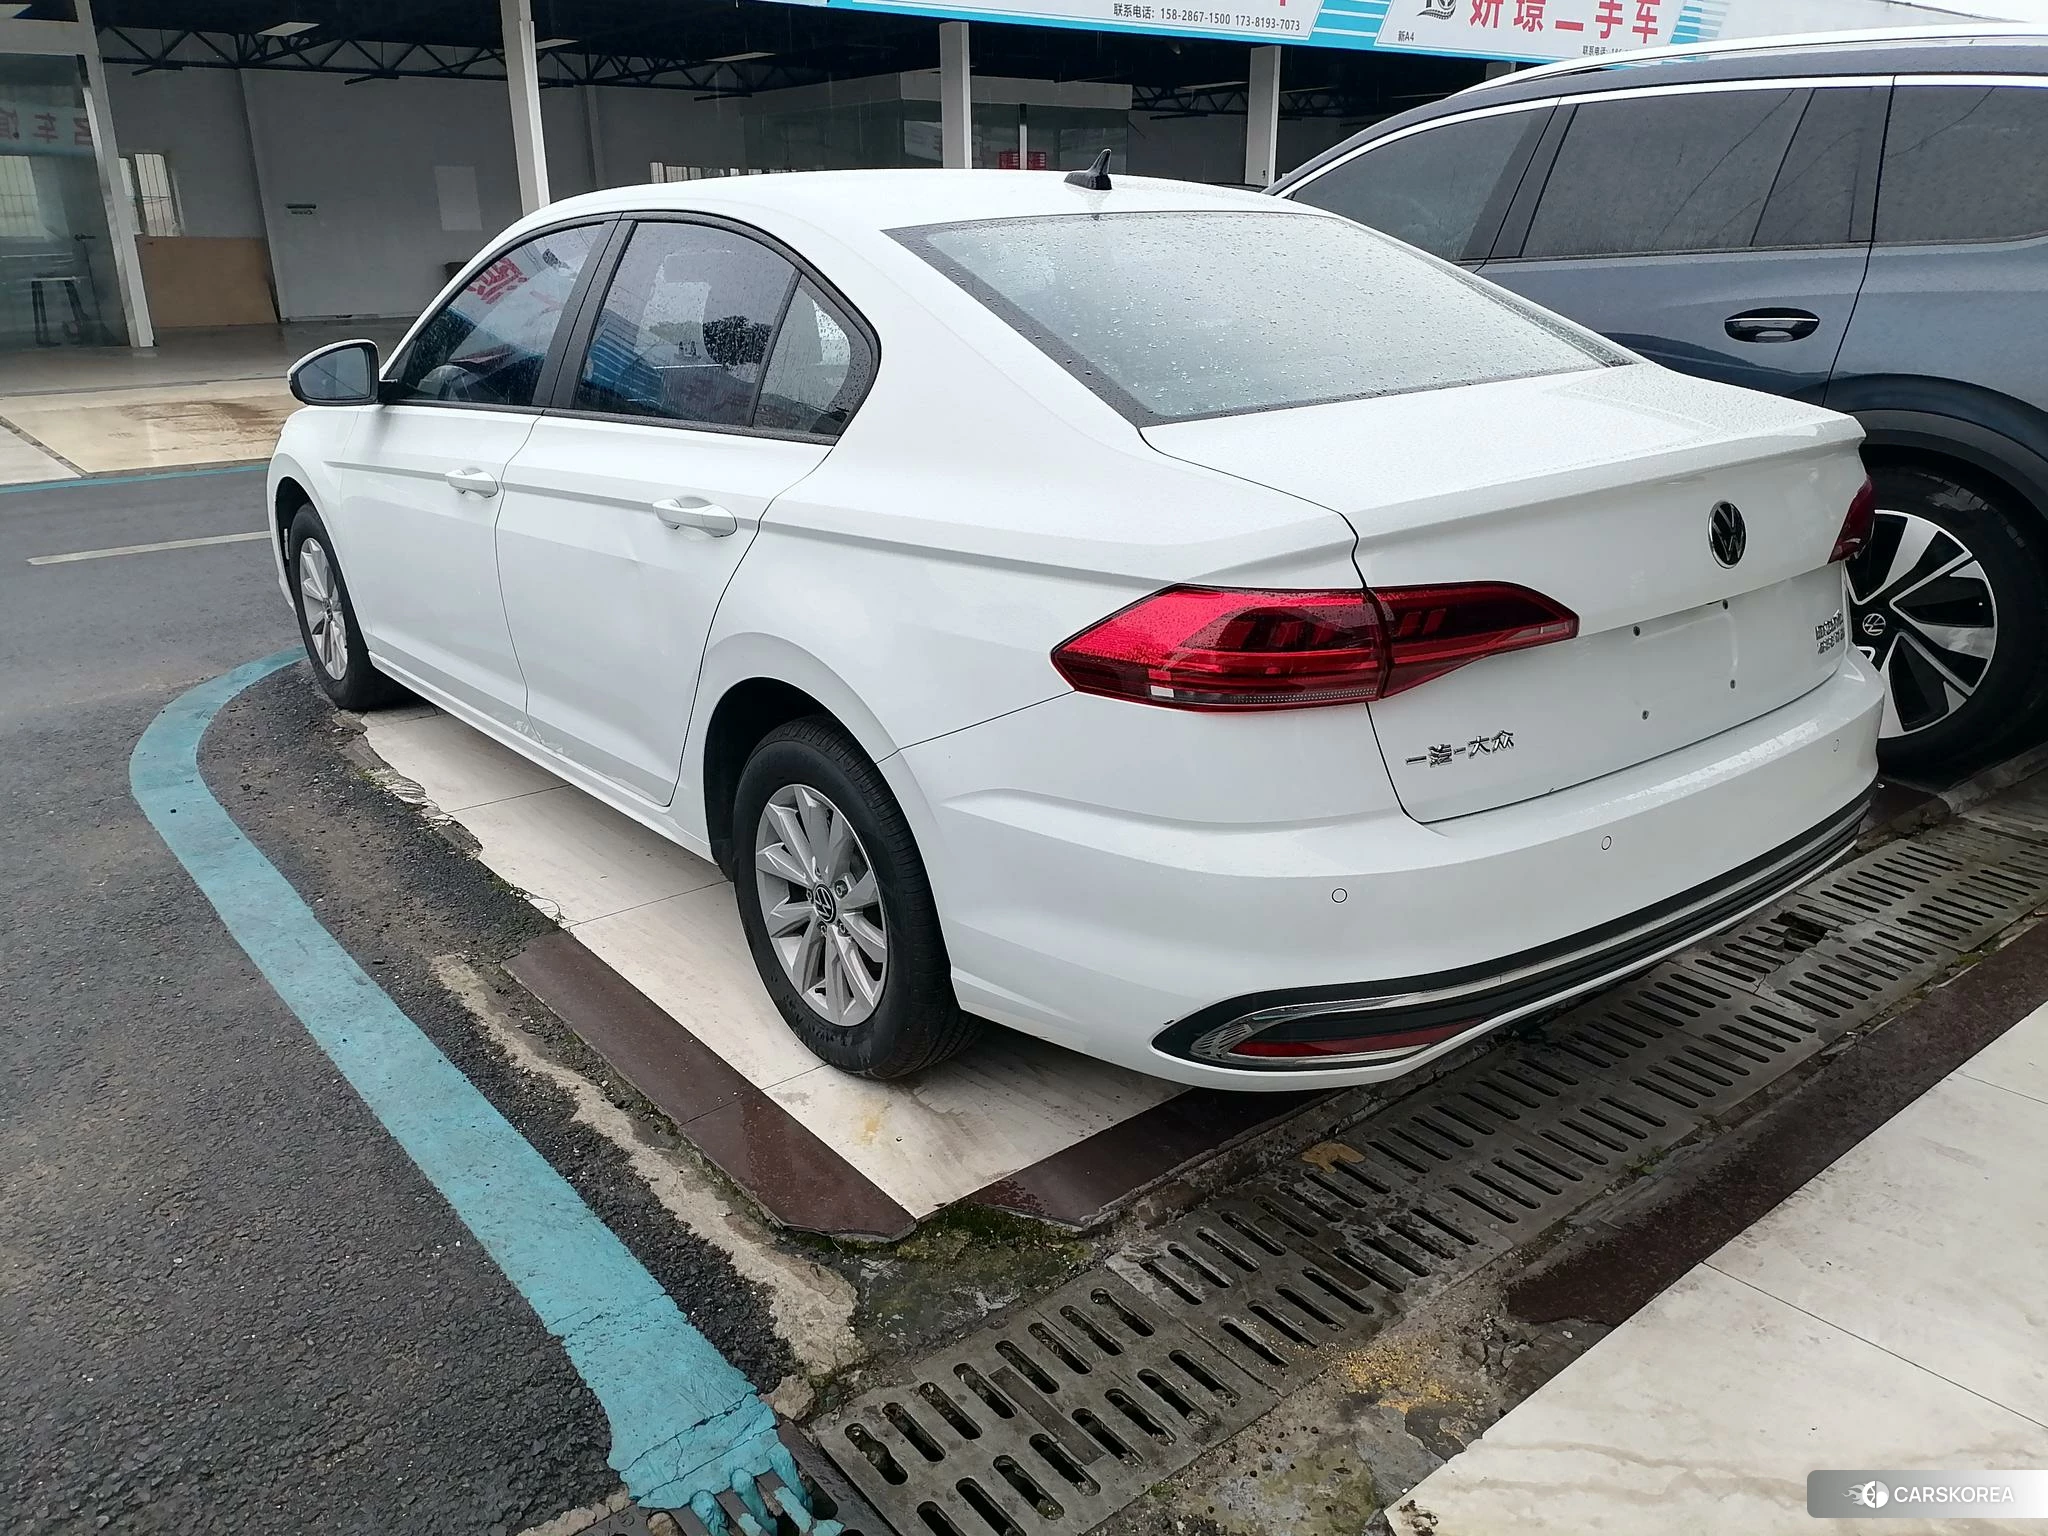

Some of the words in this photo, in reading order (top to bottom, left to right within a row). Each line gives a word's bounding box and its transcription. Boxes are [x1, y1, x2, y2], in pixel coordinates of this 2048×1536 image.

[1113, 3, 1155, 19] 联系电话：
[1160, 8, 1231, 25] 158-2867-1500
[1235, 15, 1300, 31] 173-8193-7073
